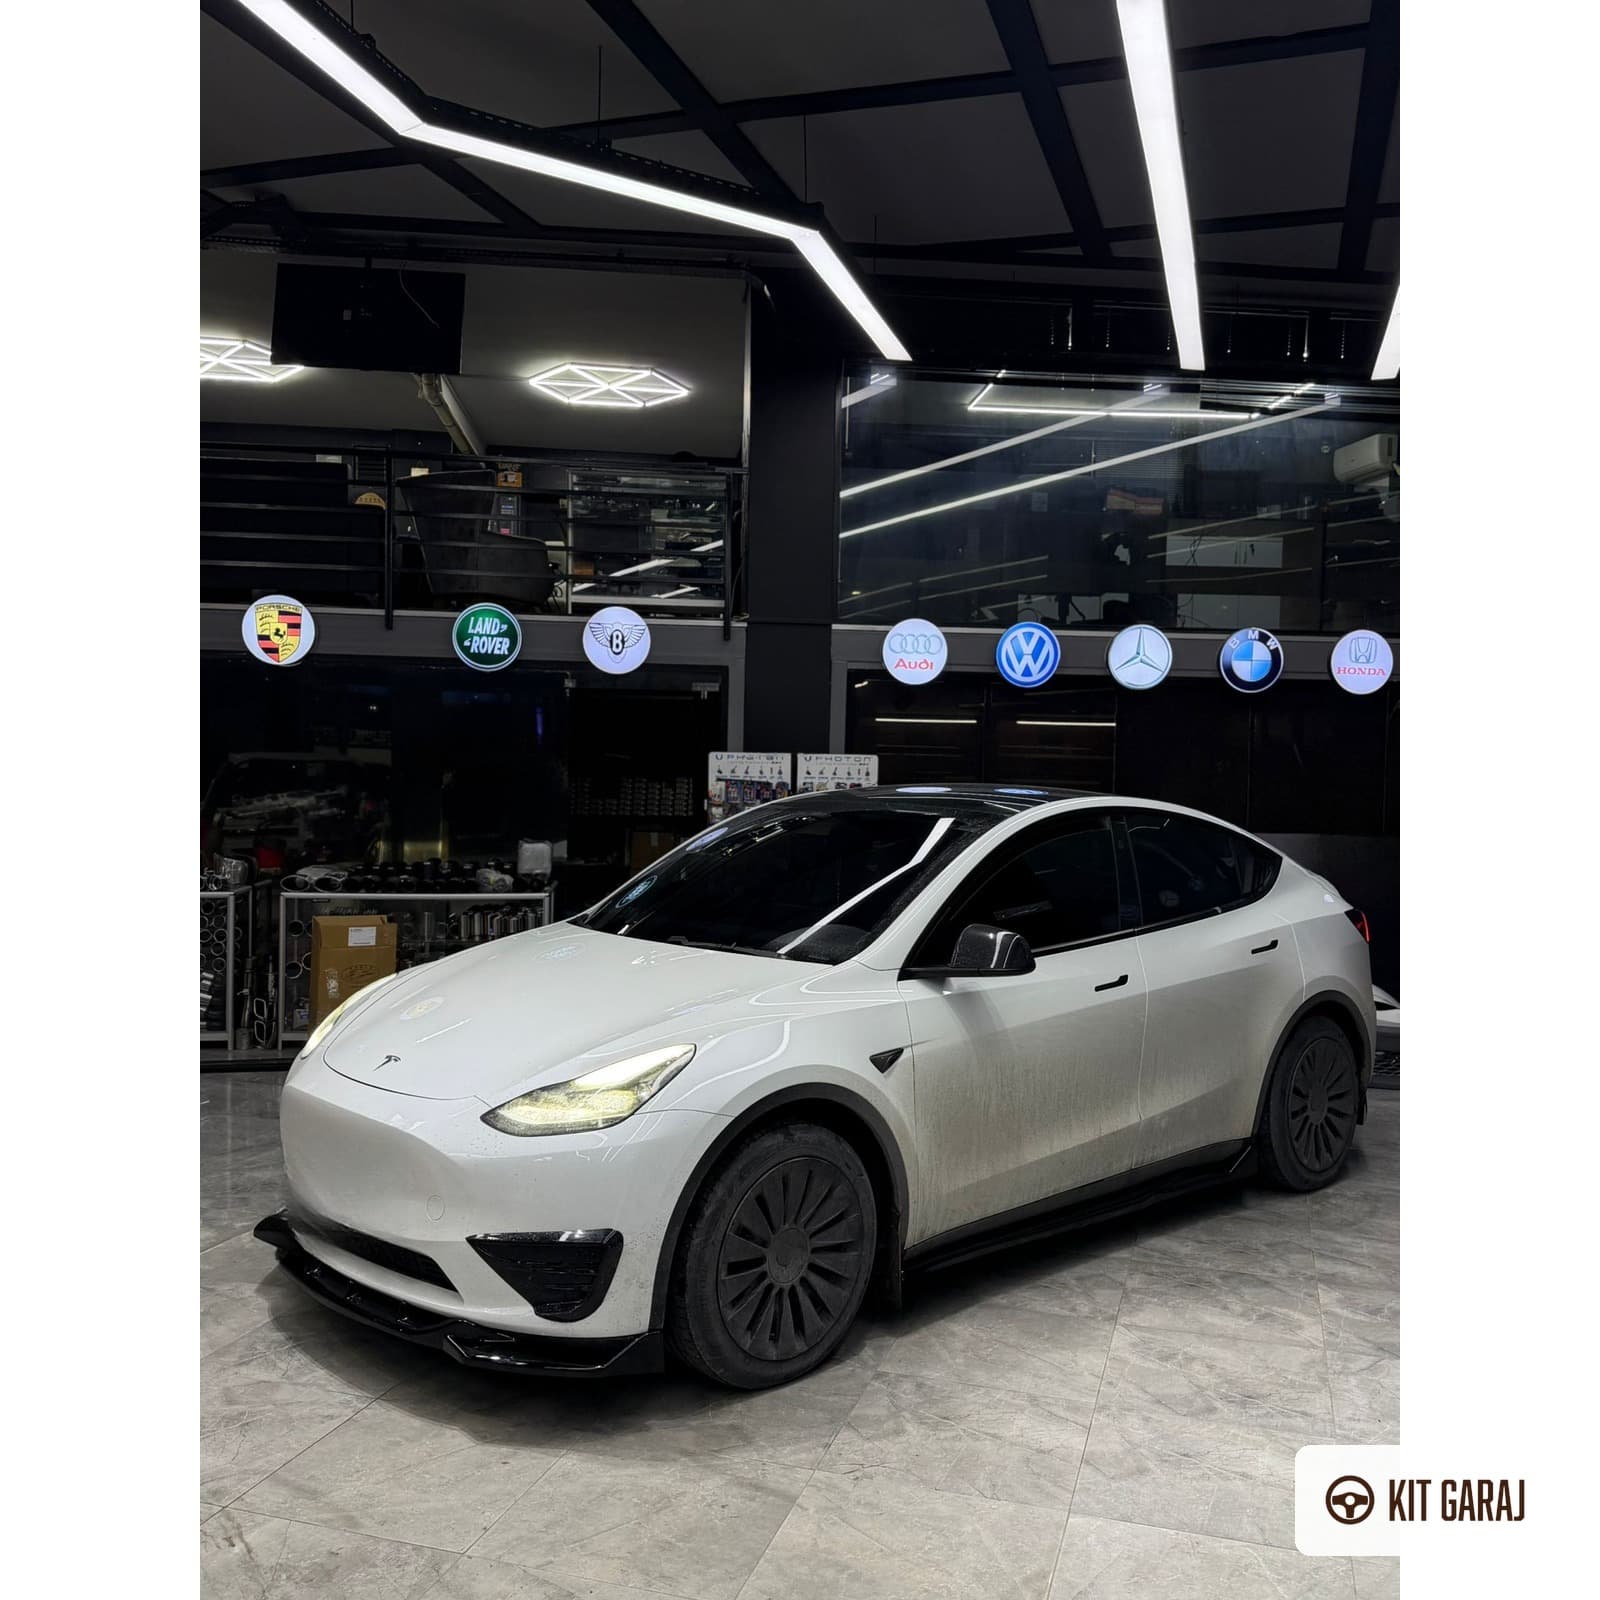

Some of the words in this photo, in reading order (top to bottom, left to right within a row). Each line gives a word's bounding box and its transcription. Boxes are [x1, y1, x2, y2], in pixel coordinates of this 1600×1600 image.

[468, 617, 501, 635] LAND
[470, 636, 510, 655] ROVER
[1228, 629, 1279, 650] BMW
[894, 658, 934, 670] Audi
[1336, 666, 1386, 676] HONDA
